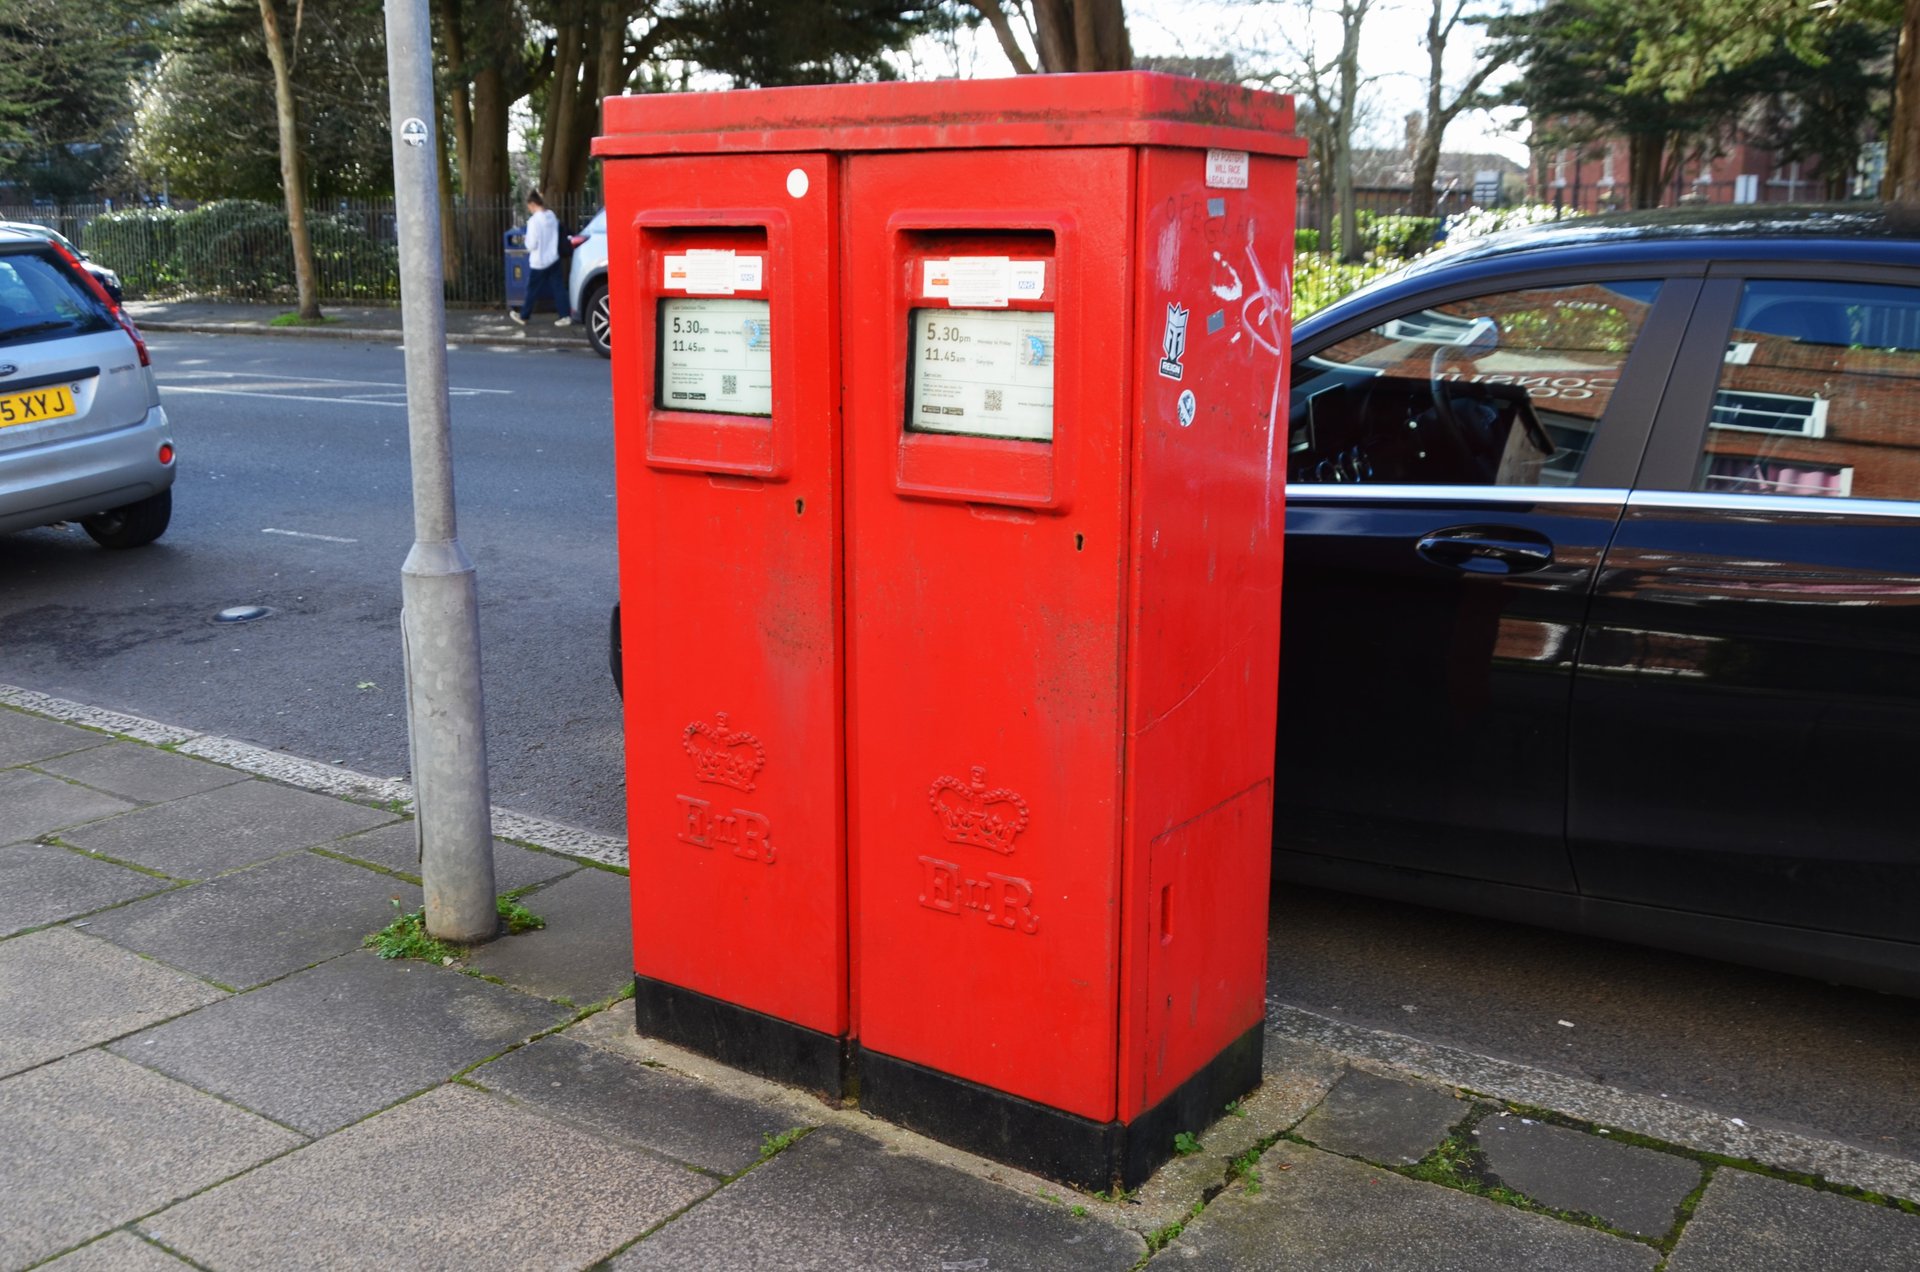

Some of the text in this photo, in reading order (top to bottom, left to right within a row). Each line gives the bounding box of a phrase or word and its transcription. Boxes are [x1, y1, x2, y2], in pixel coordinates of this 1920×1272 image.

[1210, 151, 1244, 163] FLY POSTERS
[1215, 164, 1241, 175] WILL FACE
[1208, 175, 1245, 186] LEGAL ACTION
[673, 317, 709, 334] 5.30pm
[927, 322, 971, 343] 5.30pm
[672, 340, 705, 352] 11.45am
[925, 347, 966, 363] 11.45am
[19, 391, 65, 418] XYJ
